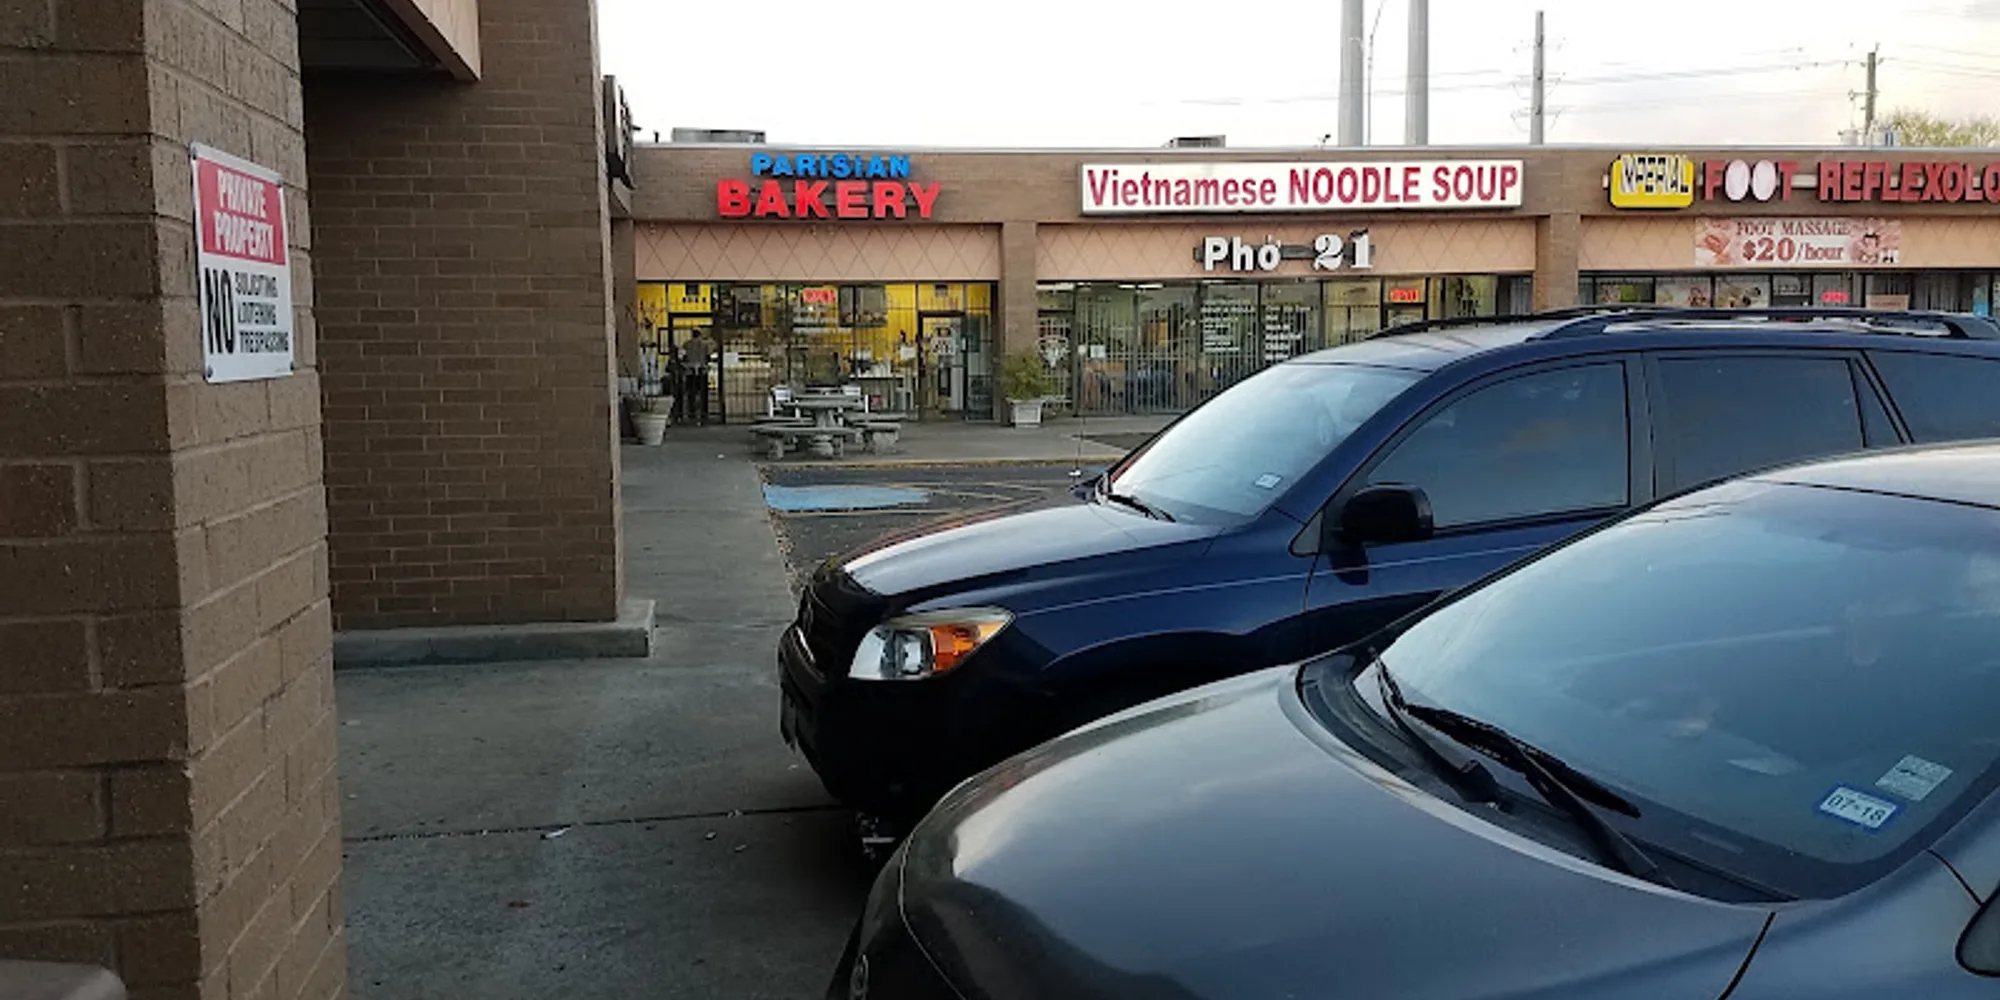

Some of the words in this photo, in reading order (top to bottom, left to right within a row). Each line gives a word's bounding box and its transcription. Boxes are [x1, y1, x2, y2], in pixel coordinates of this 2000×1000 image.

[751, 153, 911, 178] PARISIAN
[1704, 159, 1800, 201] FOOT
[217, 169, 267, 219] PRIVATE
[717, 179, 942, 219] BAKERY
[1087, 168, 1277, 207] Vietnamese
[1289, 167, 1421, 204] NOODLE
[1432, 165, 1518, 202] SOUP
[213, 210, 275, 260] PROPERTY
[1736, 221, 1775, 236] FOOT
[1781, 220, 1851, 236] MASSAGE
[1314, 233, 1373, 270] 21
[204, 267, 234, 355] NO
[239, 331, 289, 354] TRESPASSING
[1827, 794, 1887, 822] 07-18
